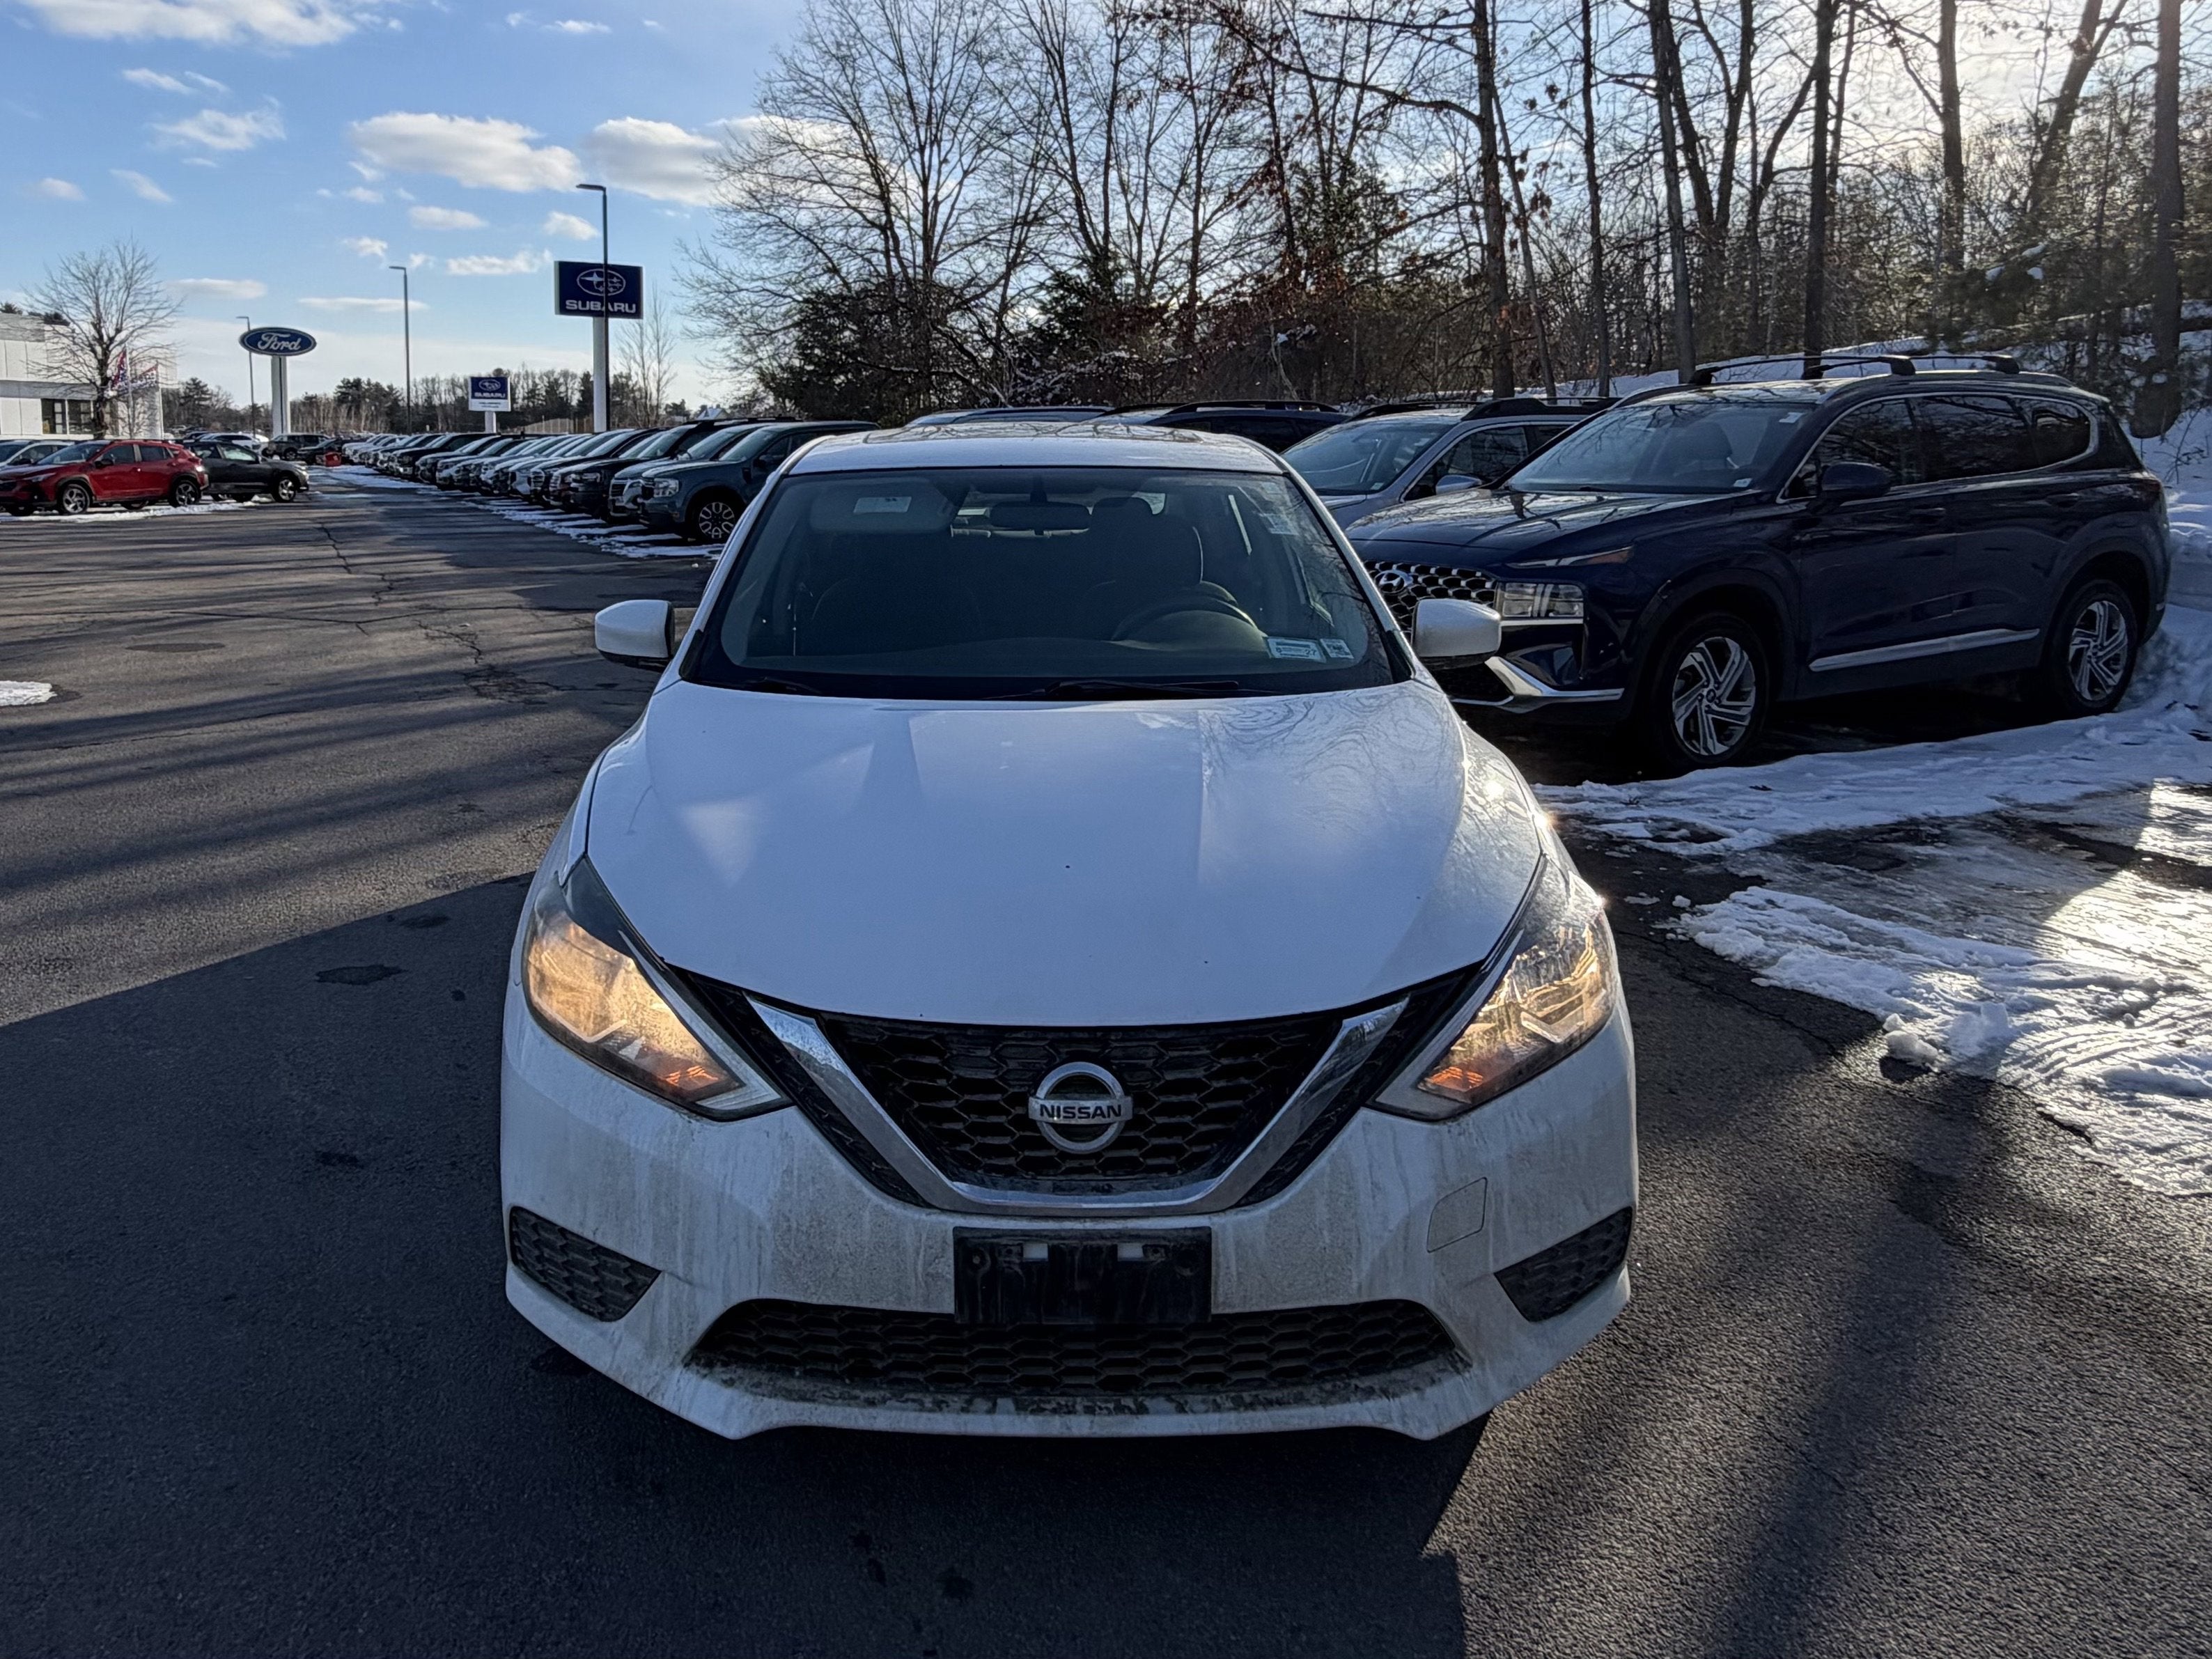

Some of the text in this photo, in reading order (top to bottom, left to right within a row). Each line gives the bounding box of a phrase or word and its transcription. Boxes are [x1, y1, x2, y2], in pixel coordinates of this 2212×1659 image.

[565, 299, 637, 313] SUBARU
[257, 332, 302, 350] Ford
[1040, 1104, 1121, 1119] NISSAN
